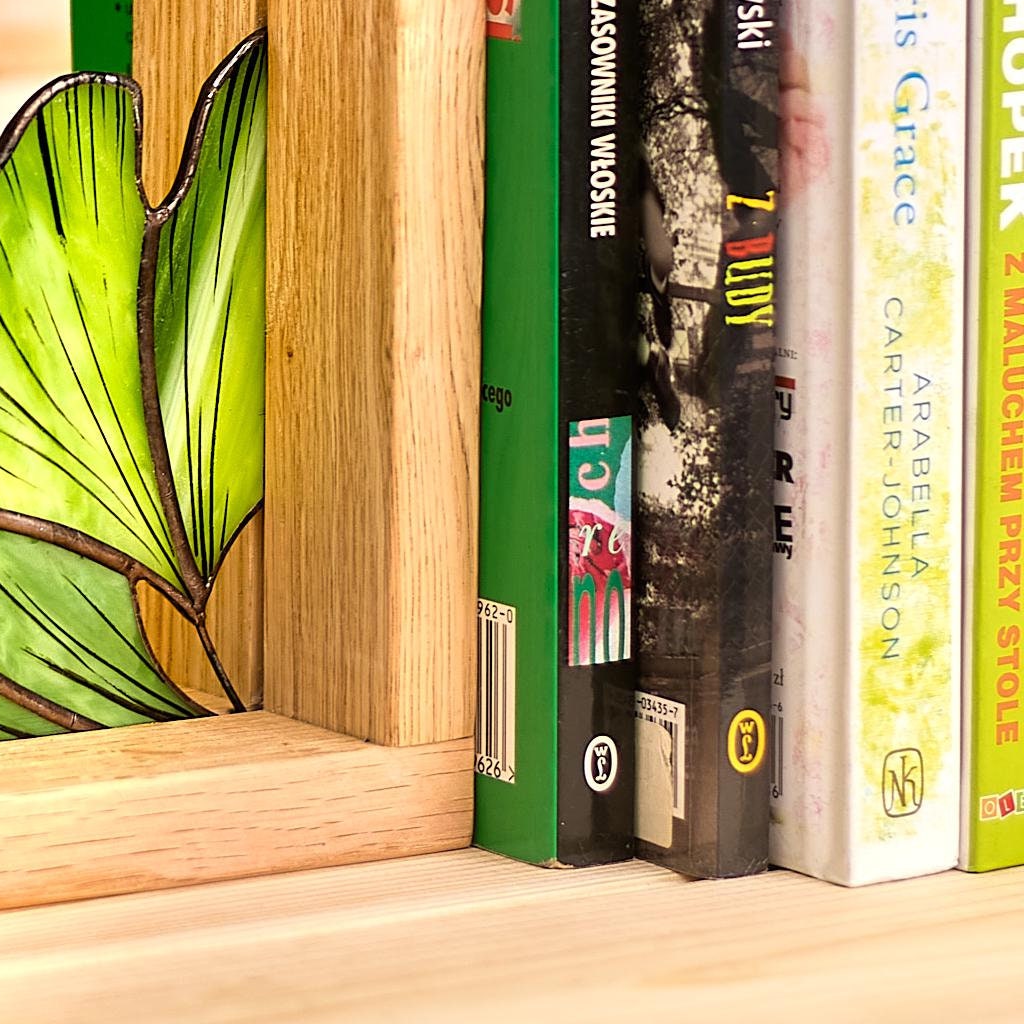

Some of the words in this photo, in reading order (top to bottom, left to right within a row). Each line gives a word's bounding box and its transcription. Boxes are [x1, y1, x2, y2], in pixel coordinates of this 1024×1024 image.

[590, 132, 616, 239] WŁOSKIE
[726, 190, 776, 212] Z
[893, 70, 930, 228] Grace
[724, 232, 775, 327] BUDY
[1000, 287, 1024, 503] MALUCHEM
[880, 296, 904, 660] CARTER-JOHNSON
[911, 372, 932, 578] ARABELLA
[997, 514, 1022, 612] PRZY
[995, 624, 1021, 746] STOLE
